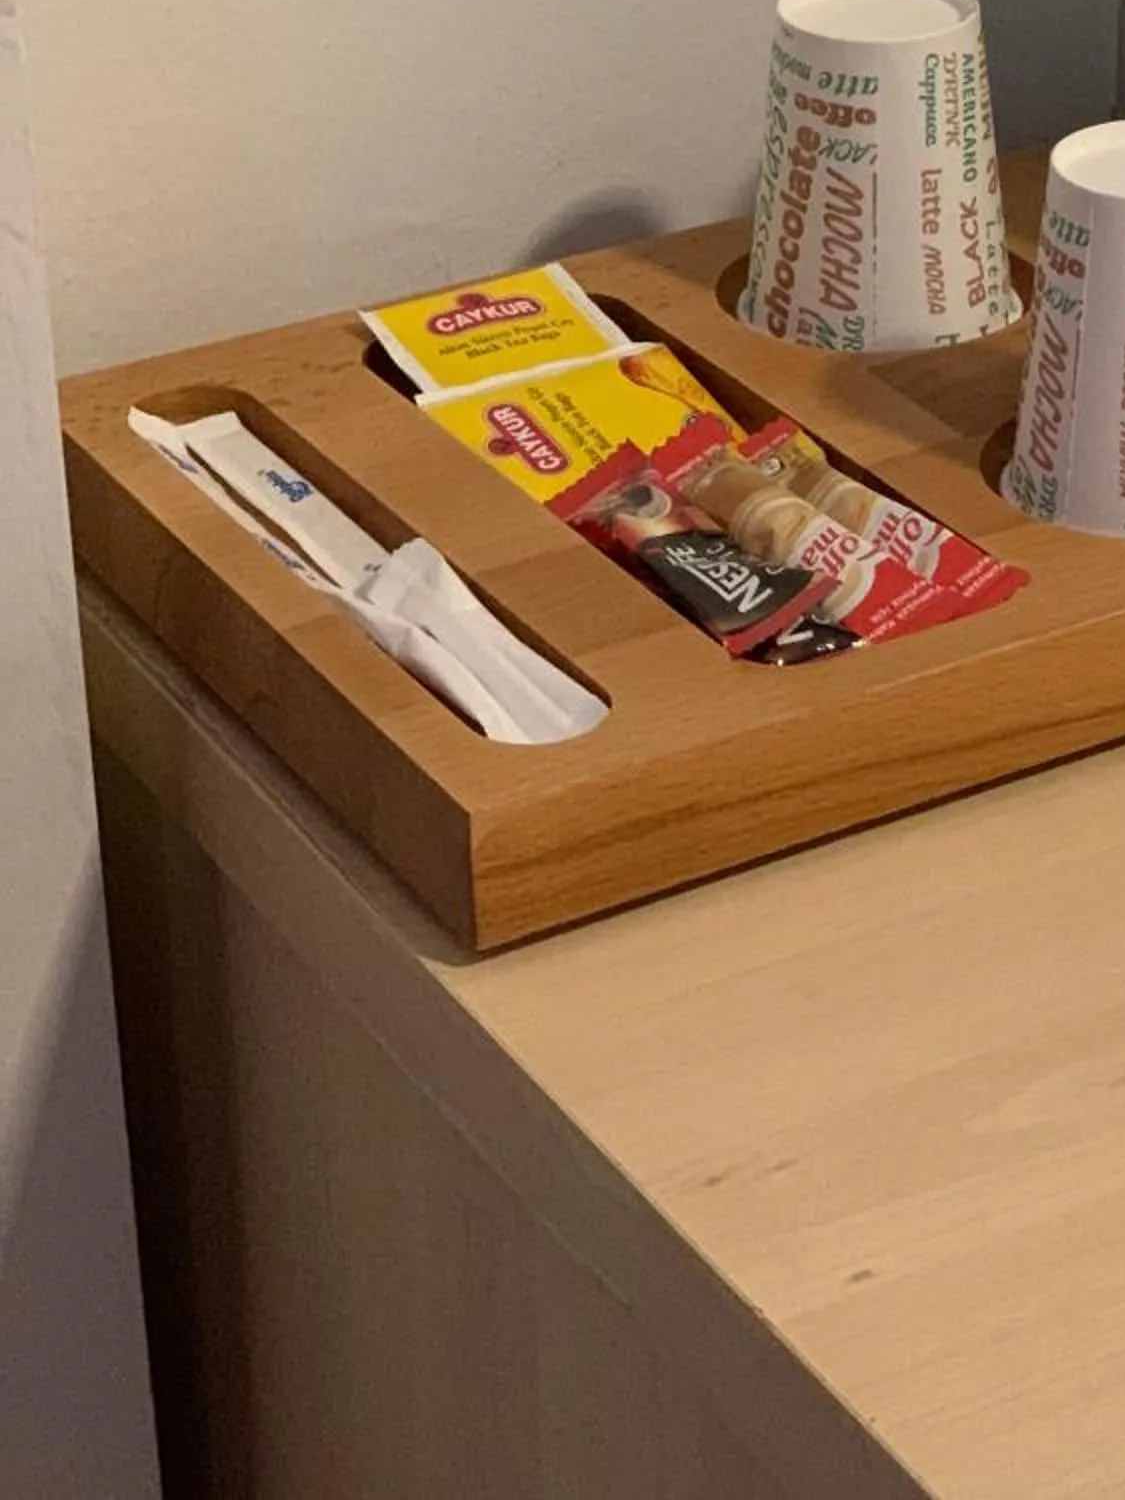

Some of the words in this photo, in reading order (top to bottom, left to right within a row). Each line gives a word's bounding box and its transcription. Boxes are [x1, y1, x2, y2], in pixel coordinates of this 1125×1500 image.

[961, 52, 980, 184] AMERICANO
[764, 125, 820, 338] chocolate
[819, 166, 865, 312] MOCHA
[920, 168, 943, 235] latte
[958, 196, 986, 308] BLACK
[1029, 311, 1070, 473] MOCHA
